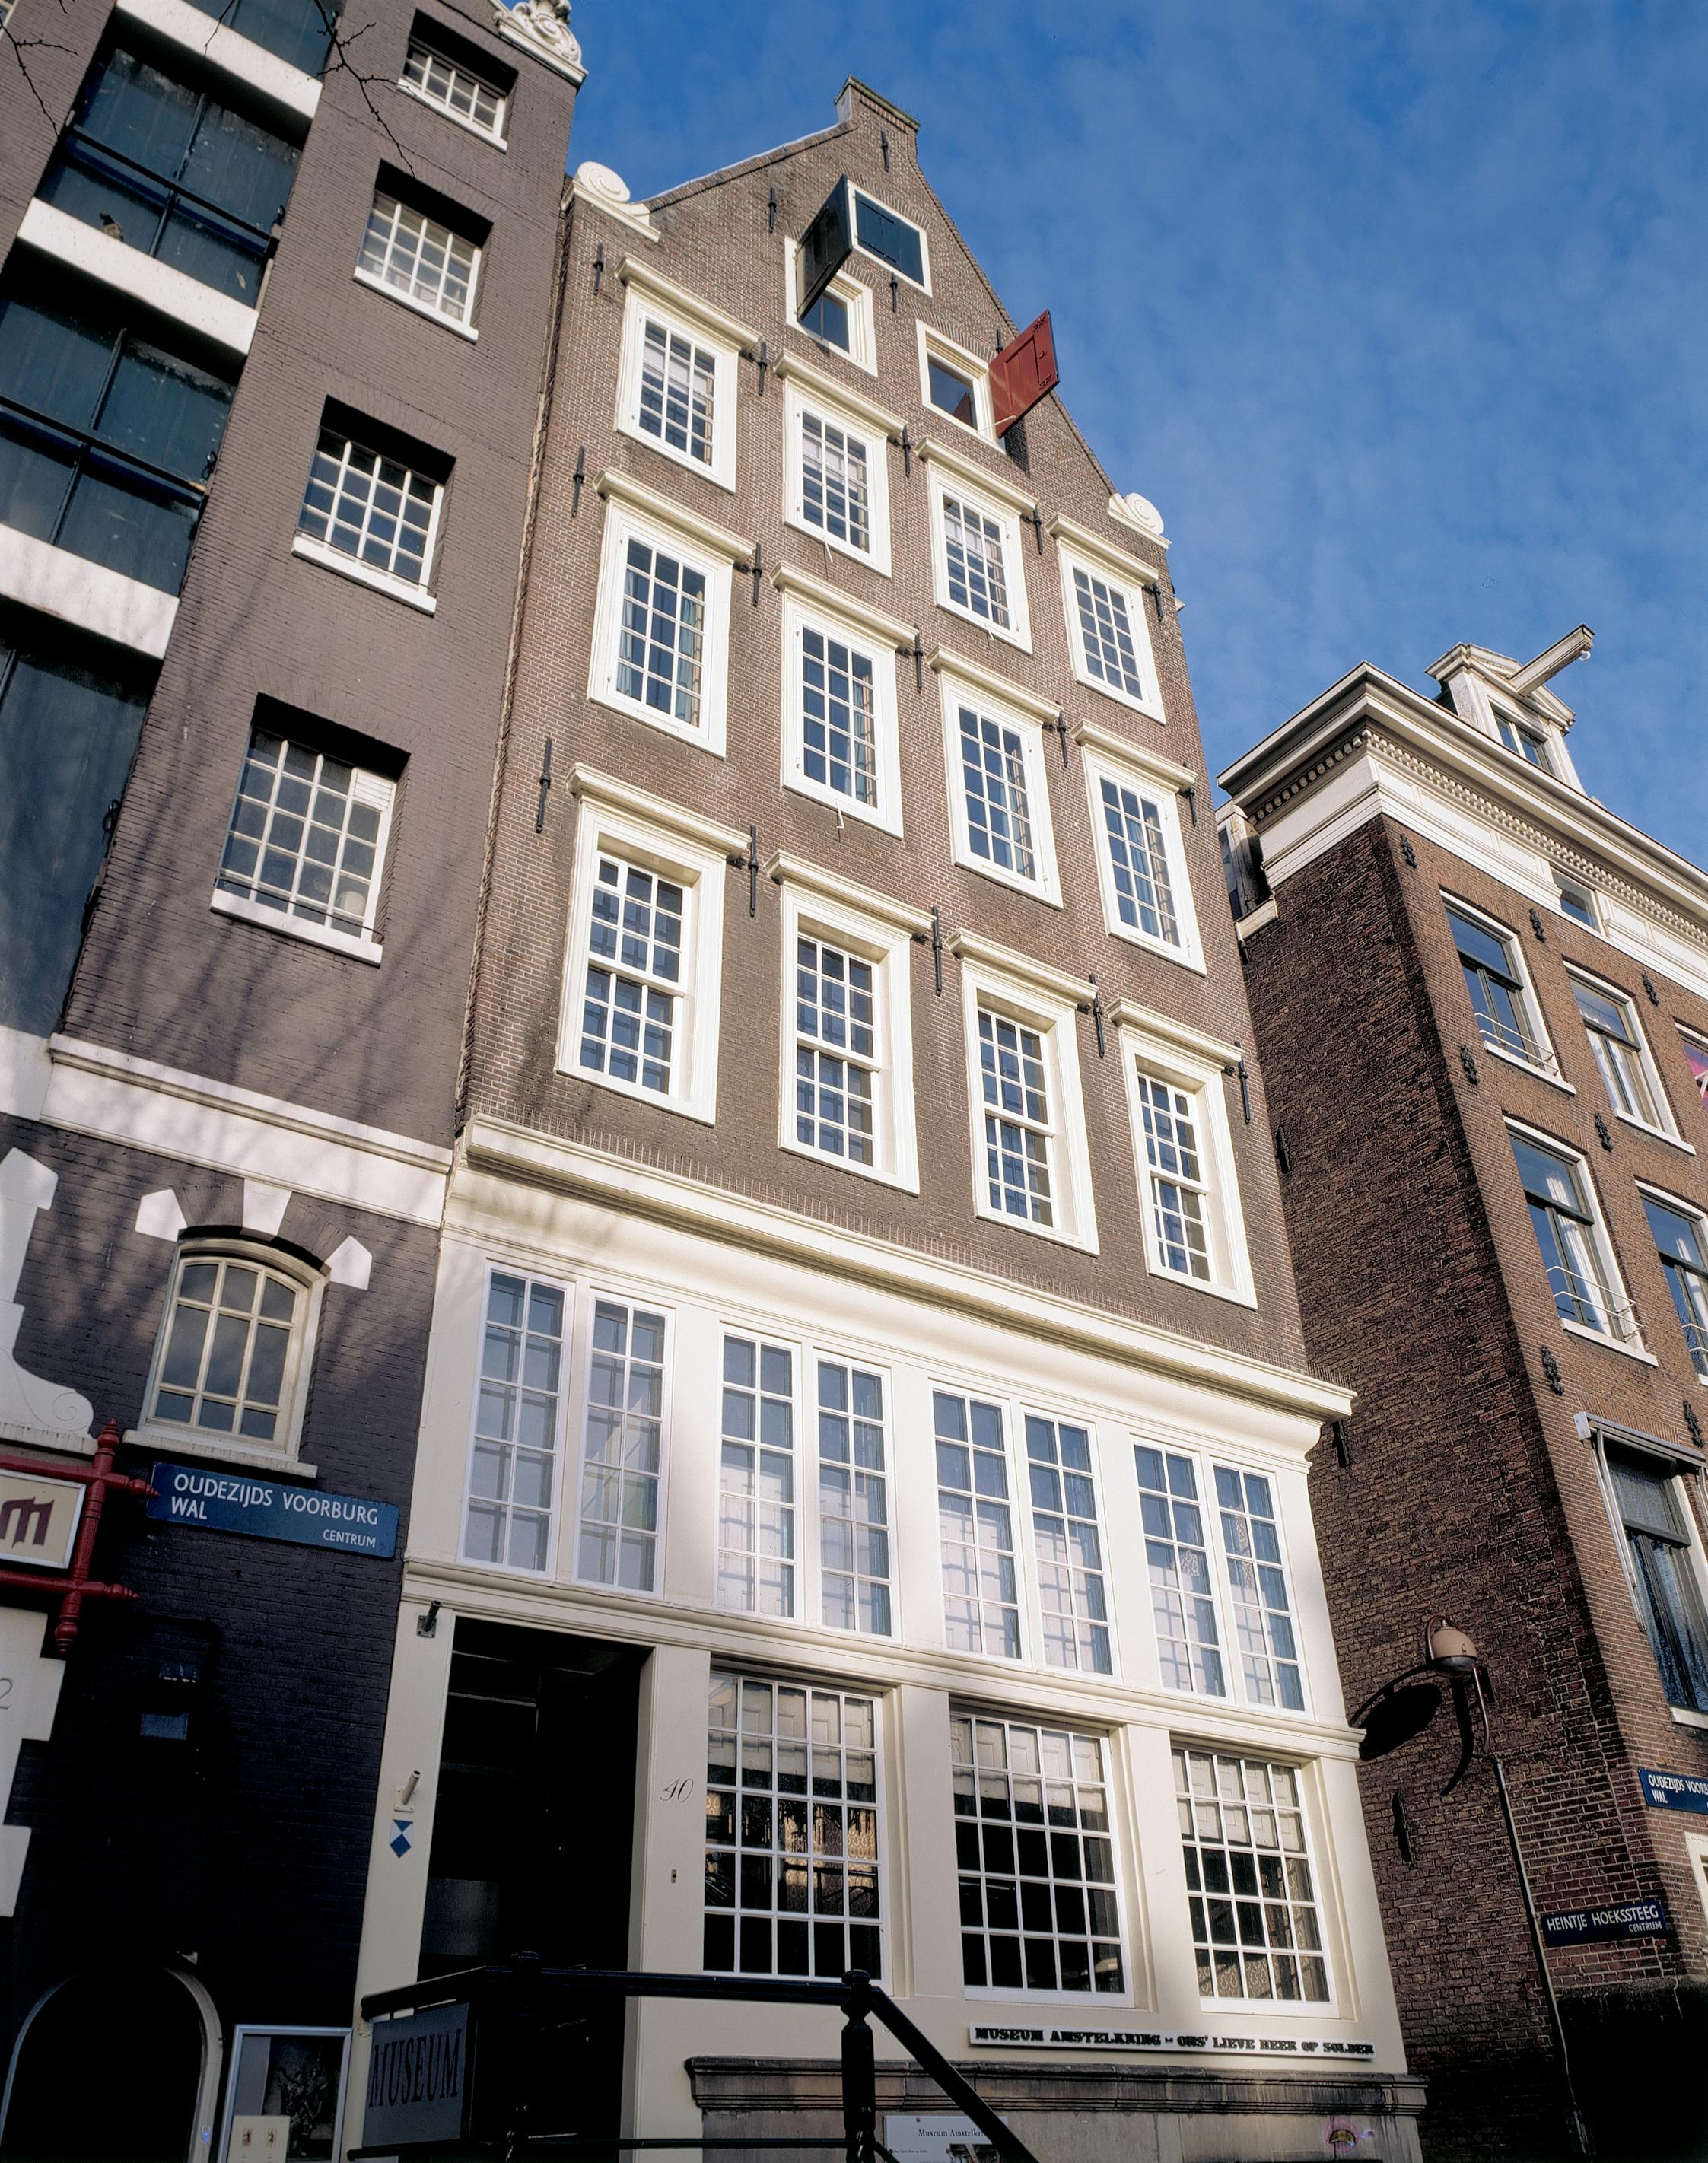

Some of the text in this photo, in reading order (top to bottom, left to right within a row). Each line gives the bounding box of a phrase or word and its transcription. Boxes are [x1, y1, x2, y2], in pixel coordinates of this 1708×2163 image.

[171, 1496, 207, 1520] WAL
[174, 1474, 378, 1525] OUDEZIJDS VOORBURG
[323, 1528, 376, 1548] CENTRUM
[659, 1777, 694, 1803] 40
[1648, 1774, 1685, 1793] OUDEZIJDS
[1652, 1789, 1668, 1804] WAL
[1546, 1904, 1659, 1932] HEINTJE HOEKSSTEEG
[1628, 1921, 1662, 1932] CENTRUM
[975, 2028, 1044, 2042] MUSEUM
[1050, 2031, 1162, 2046] AMSTELKRING
[1212, 2037, 1255, 2050] LIEVE
[1259, 2039, 1297, 2051] HEER
[1301, 2041, 1318, 2053] OP
[1322, 2042, 1375, 2055] SOLDER
[368, 2028, 463, 2107] MUSEUM
[918, 2128, 984, 2137] Museum Amstelkr
